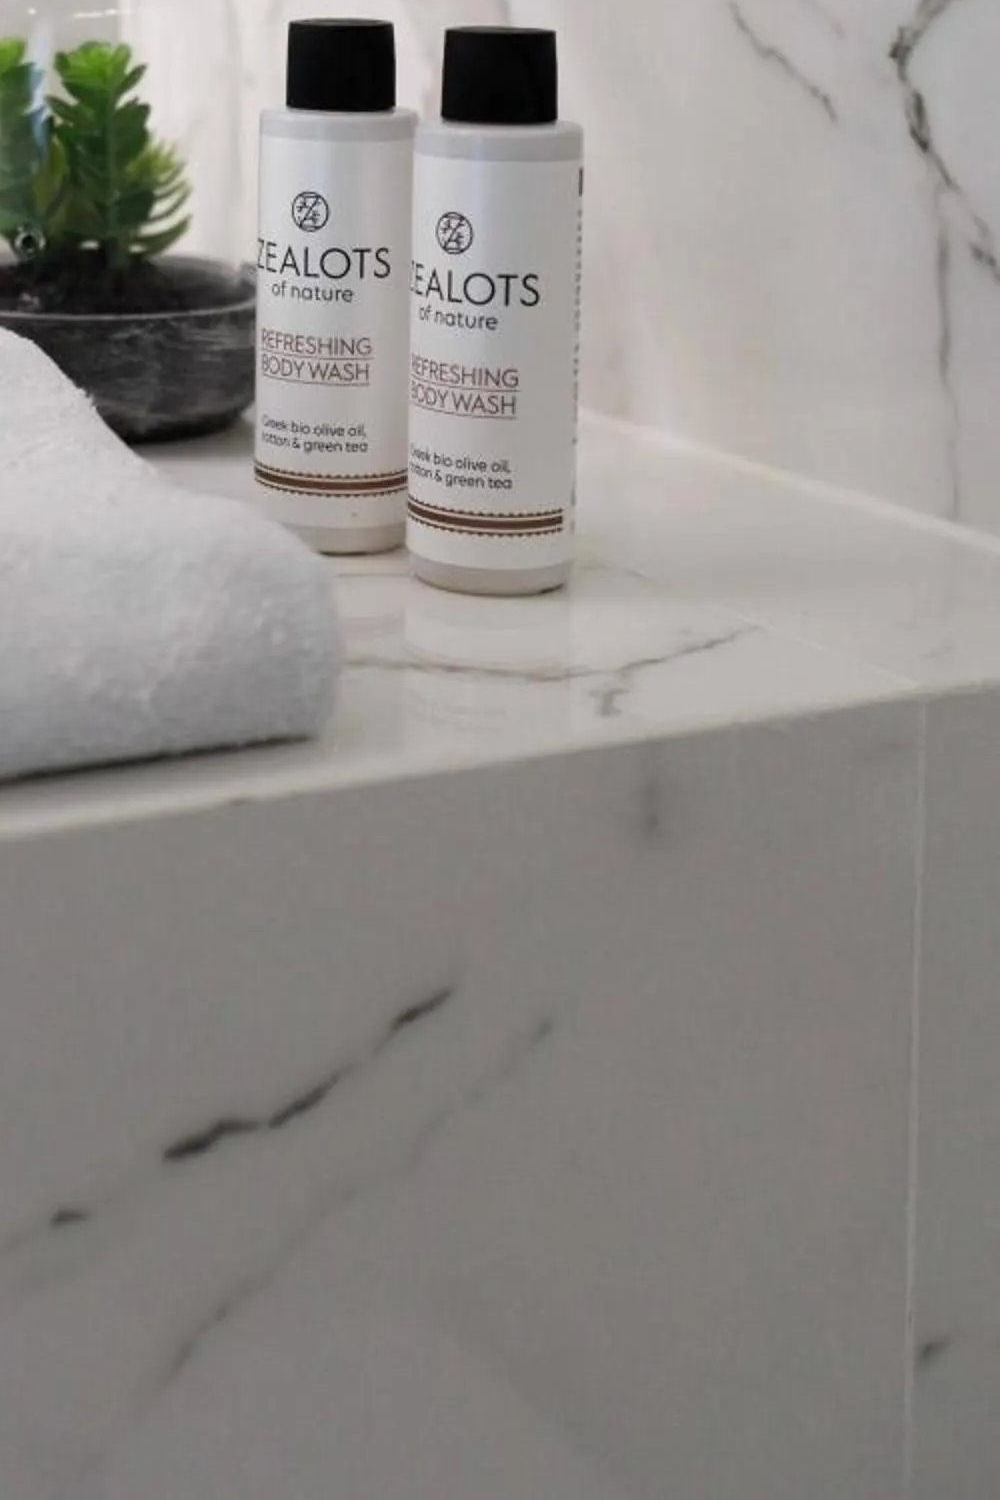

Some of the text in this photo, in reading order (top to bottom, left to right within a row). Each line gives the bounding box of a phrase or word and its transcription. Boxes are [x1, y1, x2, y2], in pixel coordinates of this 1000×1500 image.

[271, 281, 354, 302] of nature
[419, 304, 498, 330] of nature
[261, 328, 372, 356] REFRESHING
[261, 354, 370, 382] BODY WASH
[452, 392, 516, 415] WASH
[291, 420, 310, 435] bio
[313, 423, 345, 437] olive
[292, 438, 300, 449] &
[303, 440, 342, 454] green
[345, 441, 368, 453] tea
[433, 452, 452, 468] bio
[455, 456, 487, 473] olive
[445, 473, 485, 488] green
[488, 476, 513, 490] tea
